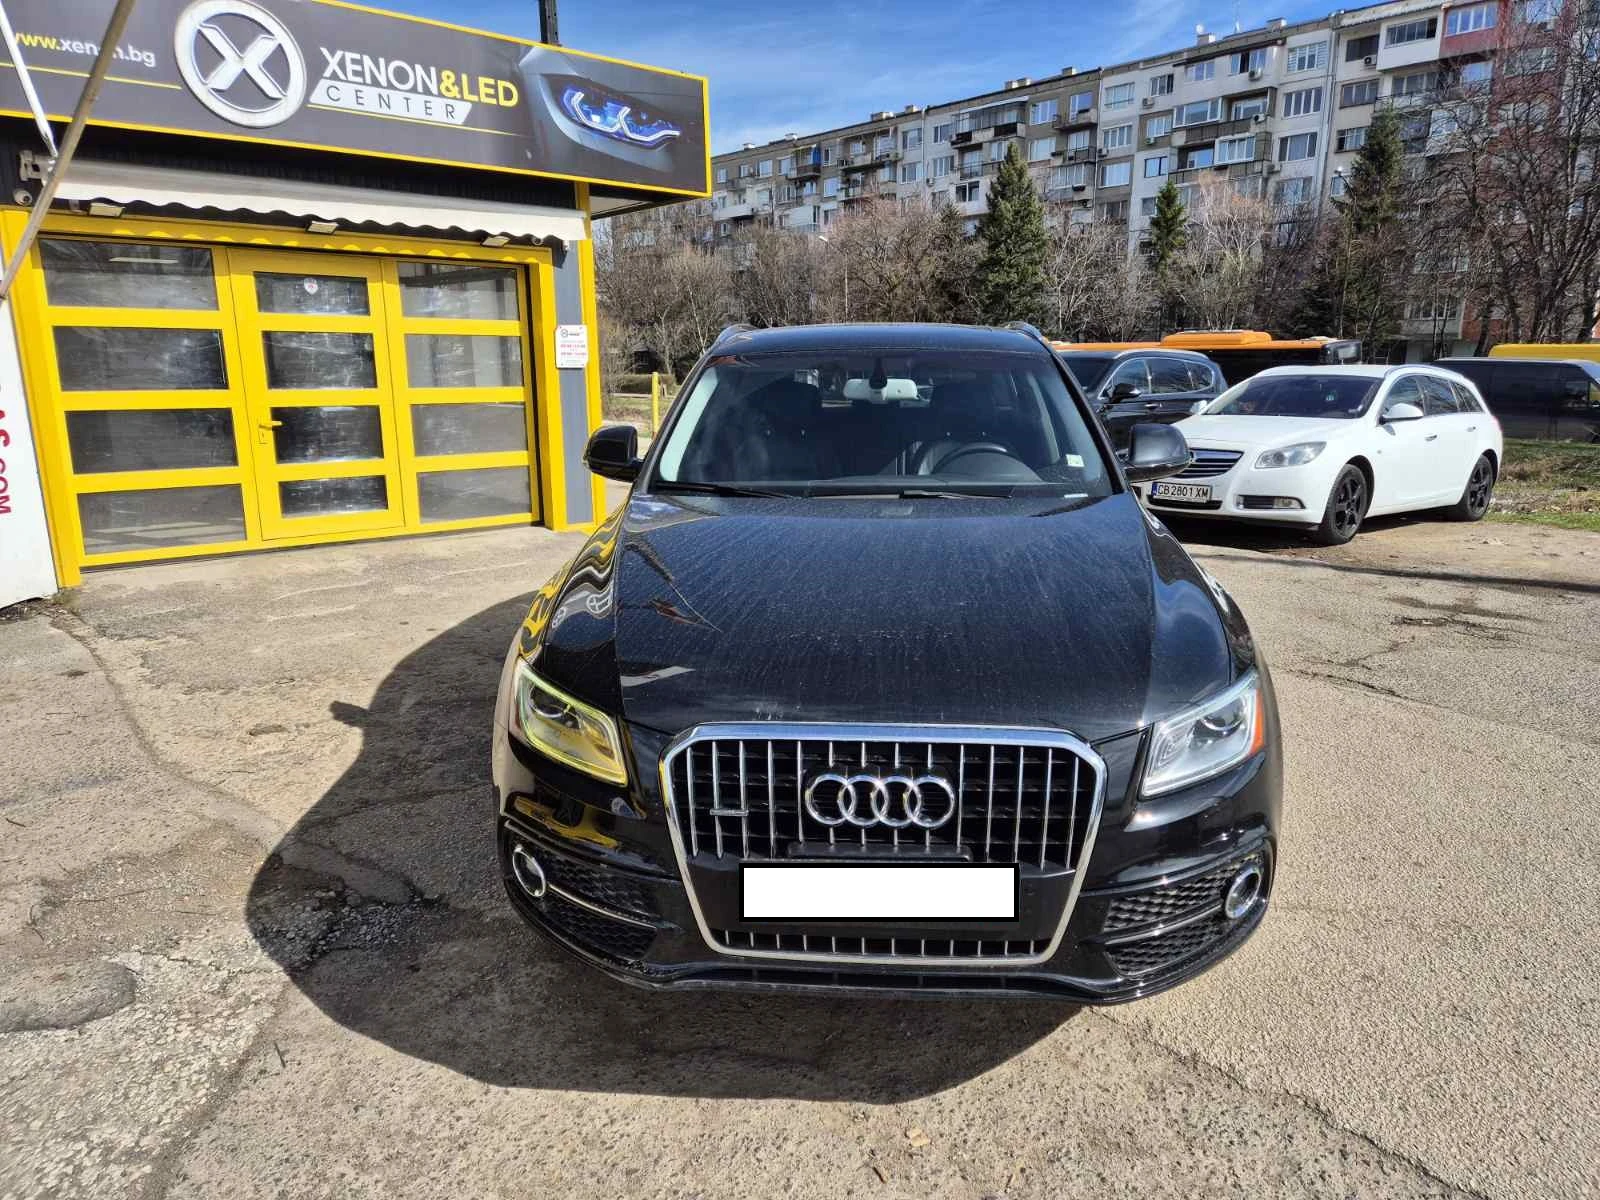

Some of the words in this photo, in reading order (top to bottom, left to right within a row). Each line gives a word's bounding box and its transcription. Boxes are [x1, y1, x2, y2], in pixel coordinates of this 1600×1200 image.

[15, 32, 156, 67] ww.xenn.bg
[320, 47, 519, 107] XENON&LED
[326, 85, 455, 119] CENTER
[1158, 485, 1170, 495] CB
[1171, 486, 1193, 497] 2801
[1195, 487, 1209, 498] XM
